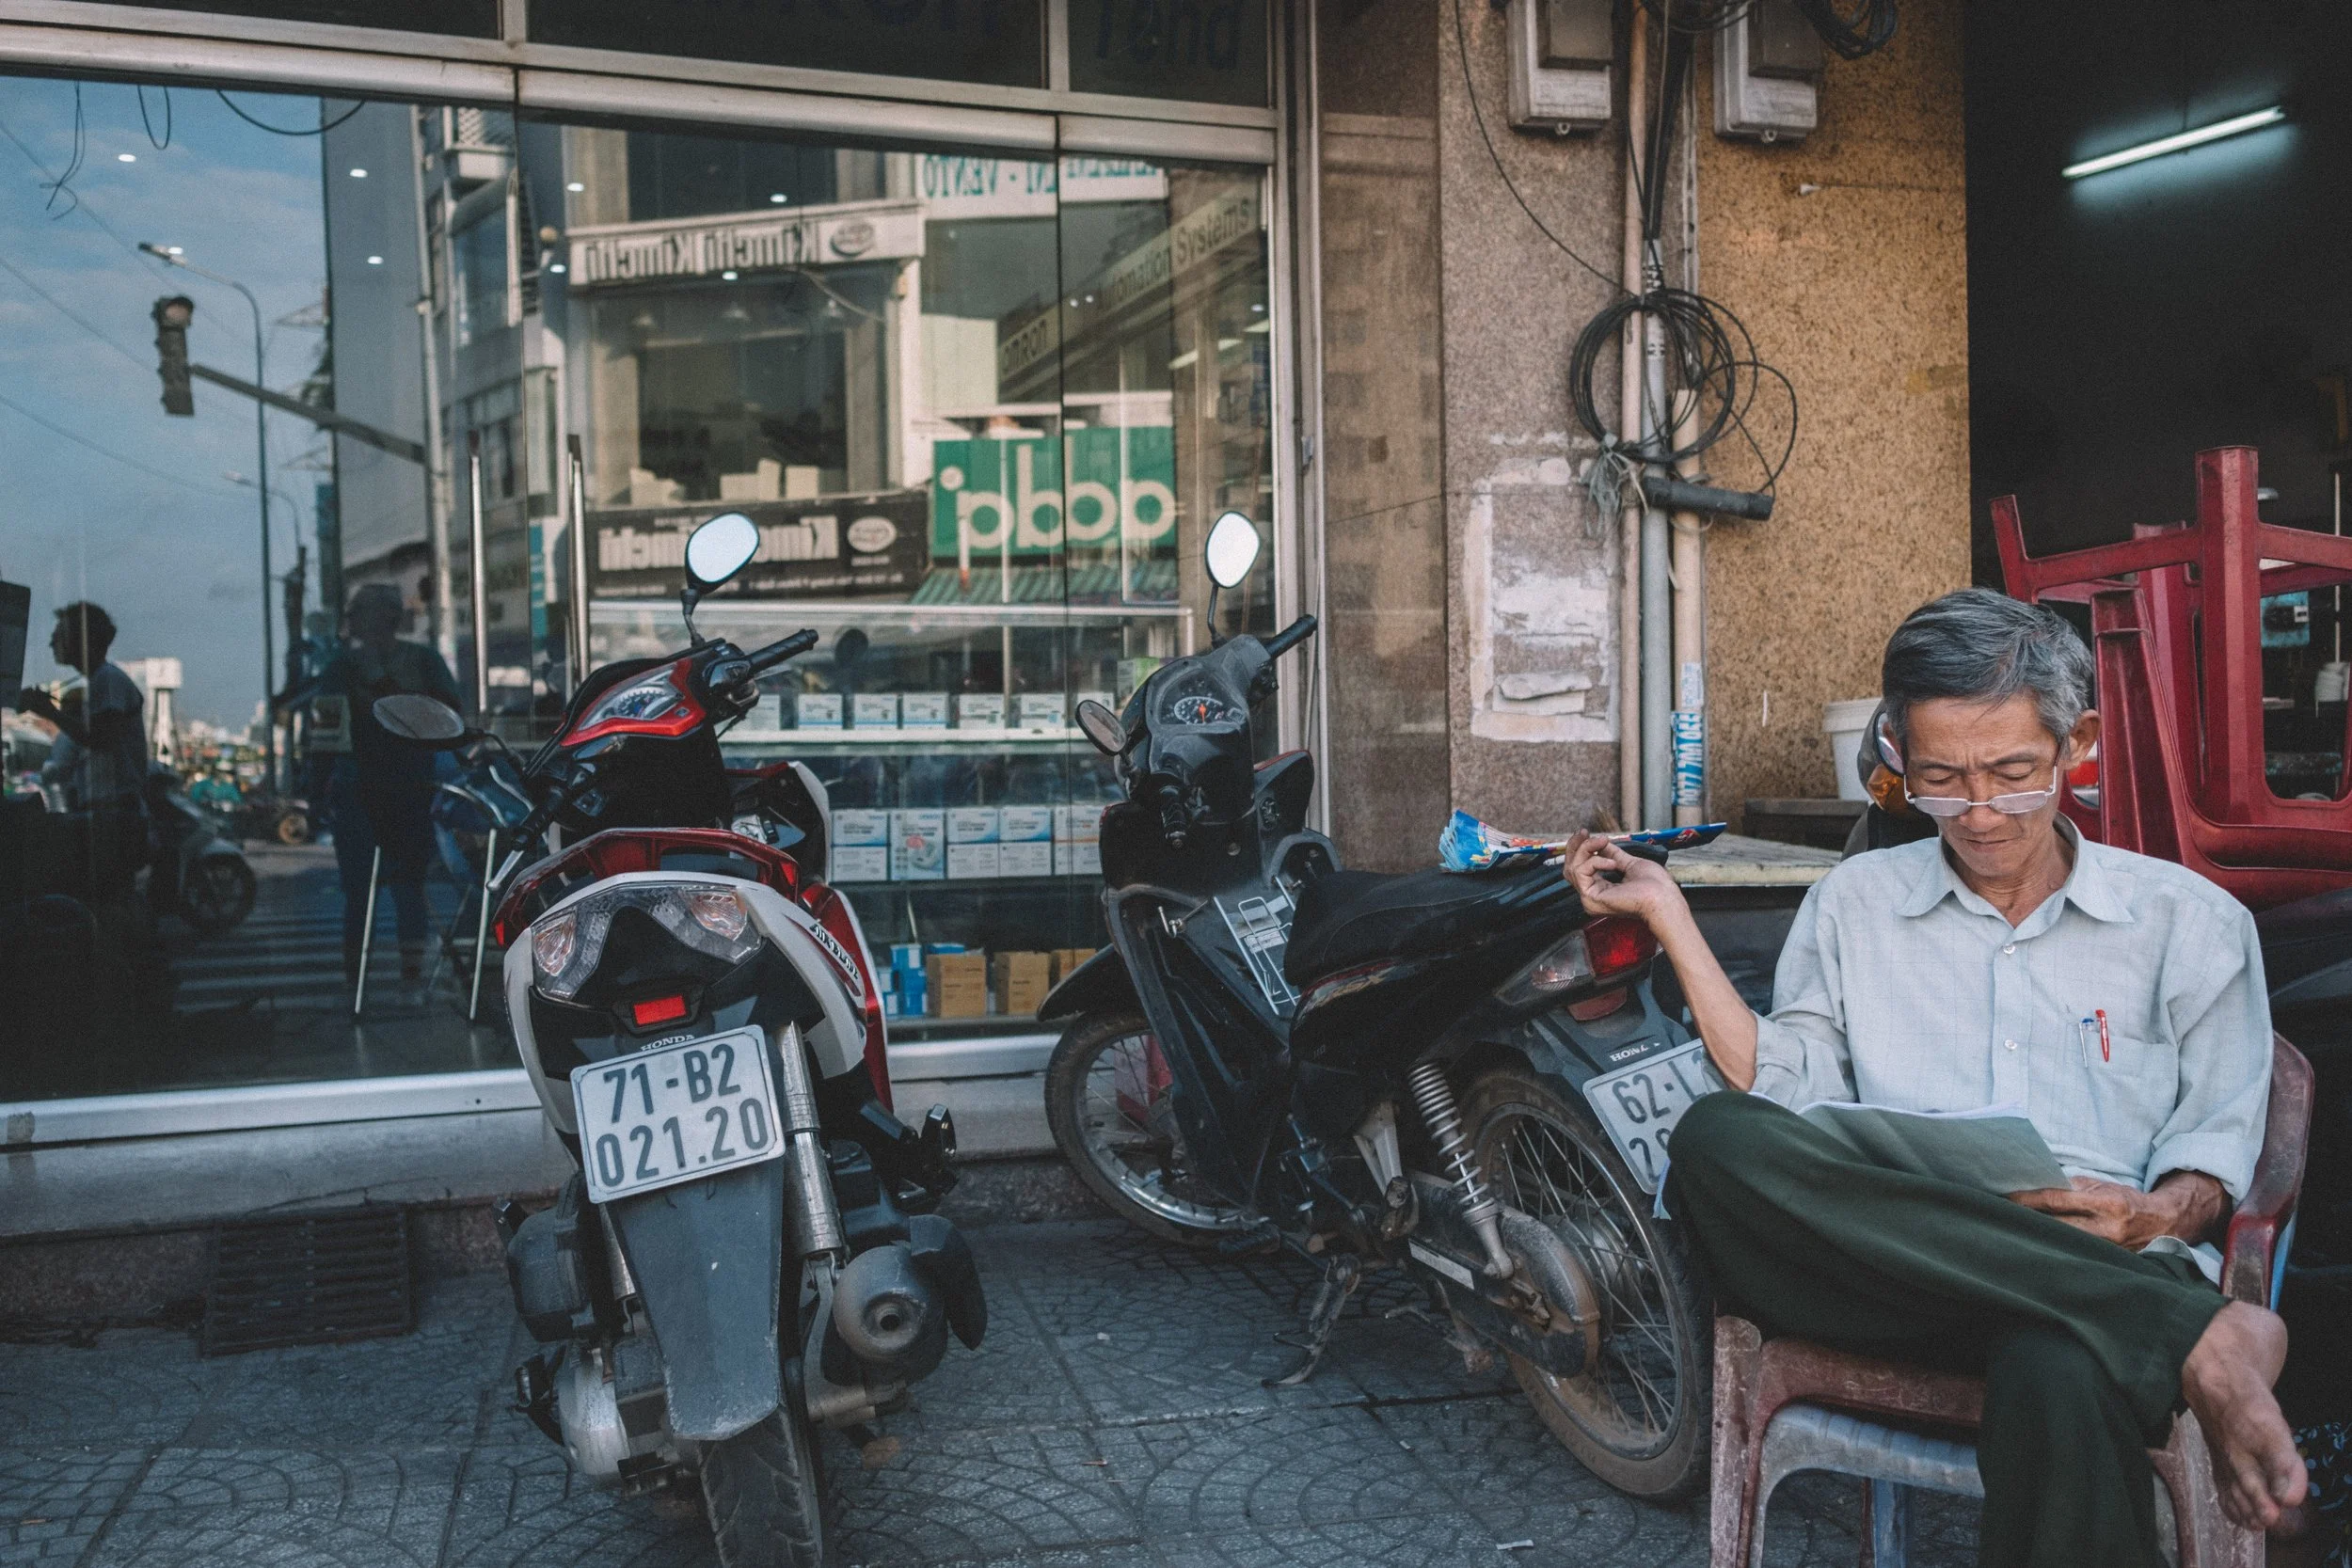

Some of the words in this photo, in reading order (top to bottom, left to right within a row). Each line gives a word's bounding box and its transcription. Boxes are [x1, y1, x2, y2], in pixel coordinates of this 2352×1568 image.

[1176, 198, 1250, 264] Systems
[640, 1034, 695, 1052] HONDA
[602, 1043, 741, 1123] 71-B2
[596, 1097, 769, 1188] 021.20
